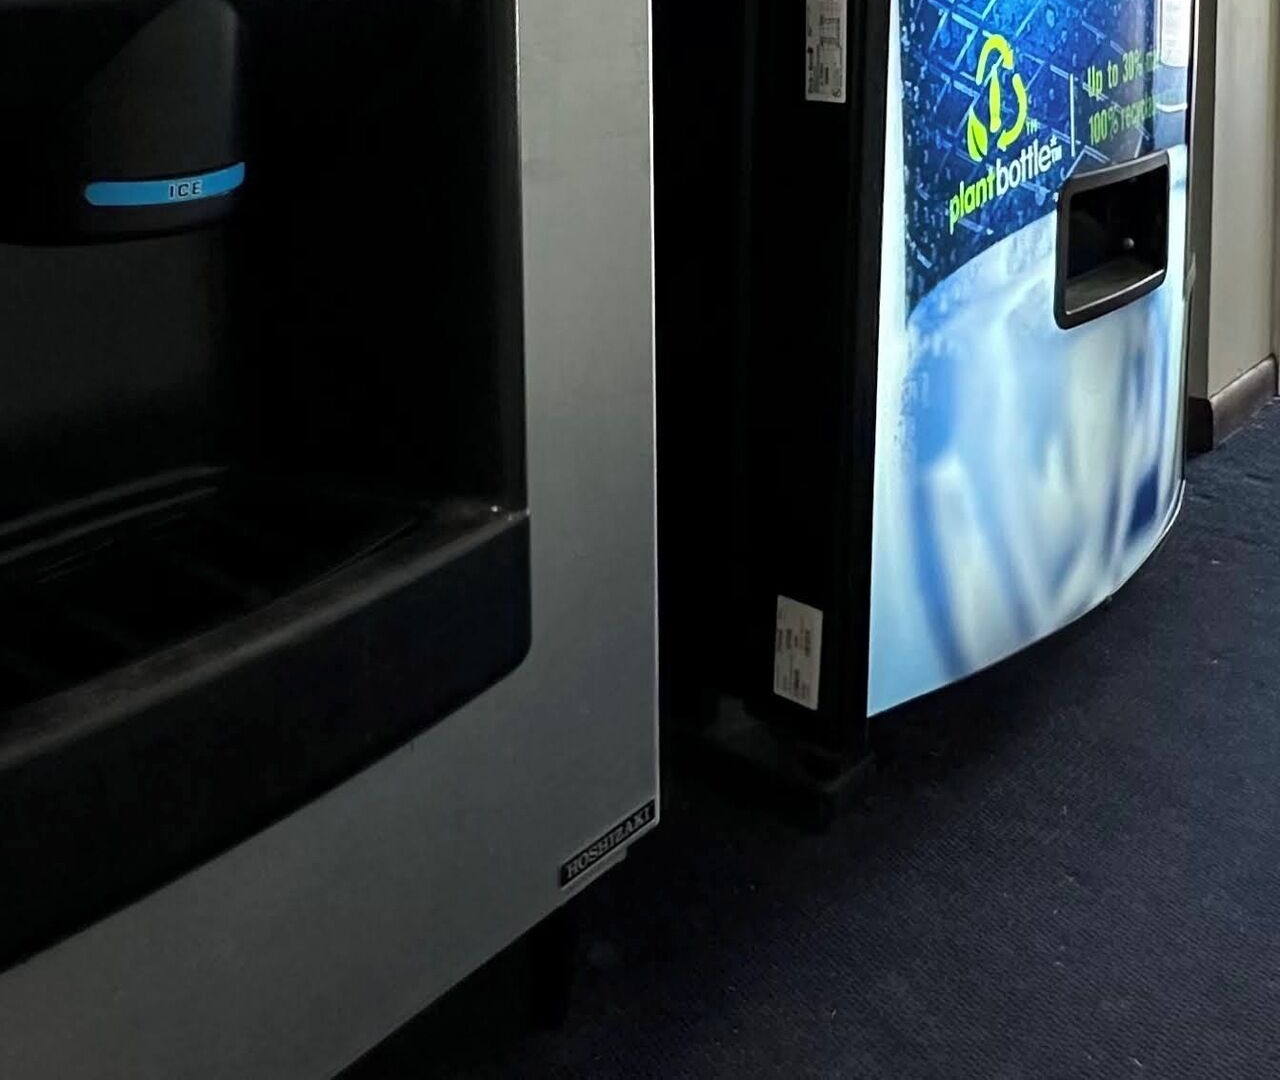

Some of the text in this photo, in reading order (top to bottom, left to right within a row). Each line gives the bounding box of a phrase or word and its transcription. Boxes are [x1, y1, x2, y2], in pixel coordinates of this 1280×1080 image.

[1087, 64, 1104, 101] Up
[1107, 59, 1119, 89] to
[1089, 106, 1119, 147] 100%
[169, 180, 203, 199] ICE
[565, 806, 650, 879] HOSHIZAKI
